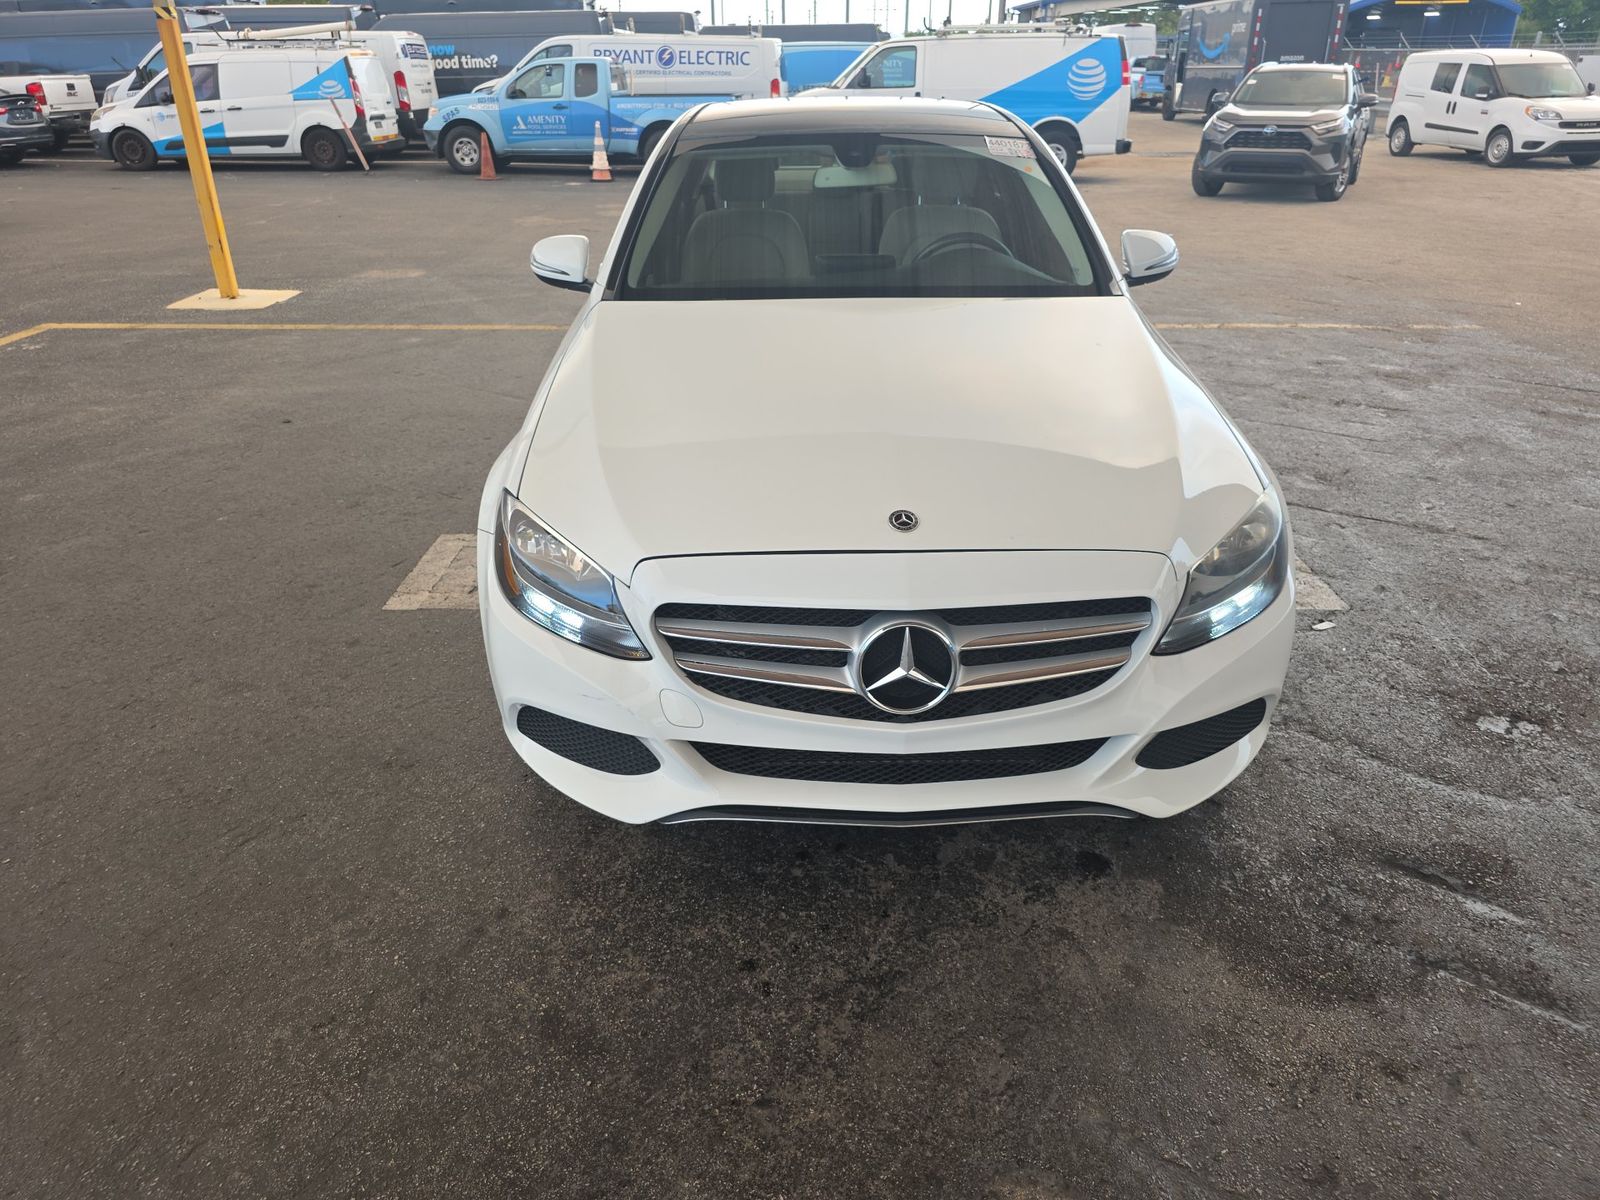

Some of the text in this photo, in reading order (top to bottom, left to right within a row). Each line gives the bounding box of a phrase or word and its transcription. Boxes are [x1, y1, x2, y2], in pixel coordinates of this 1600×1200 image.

[461, 54, 498, 69] time?
[679, 50, 750, 66] ELECTRIC
[442, 107, 460, 122] SPAS
[528, 115, 567, 124] AMENITY
